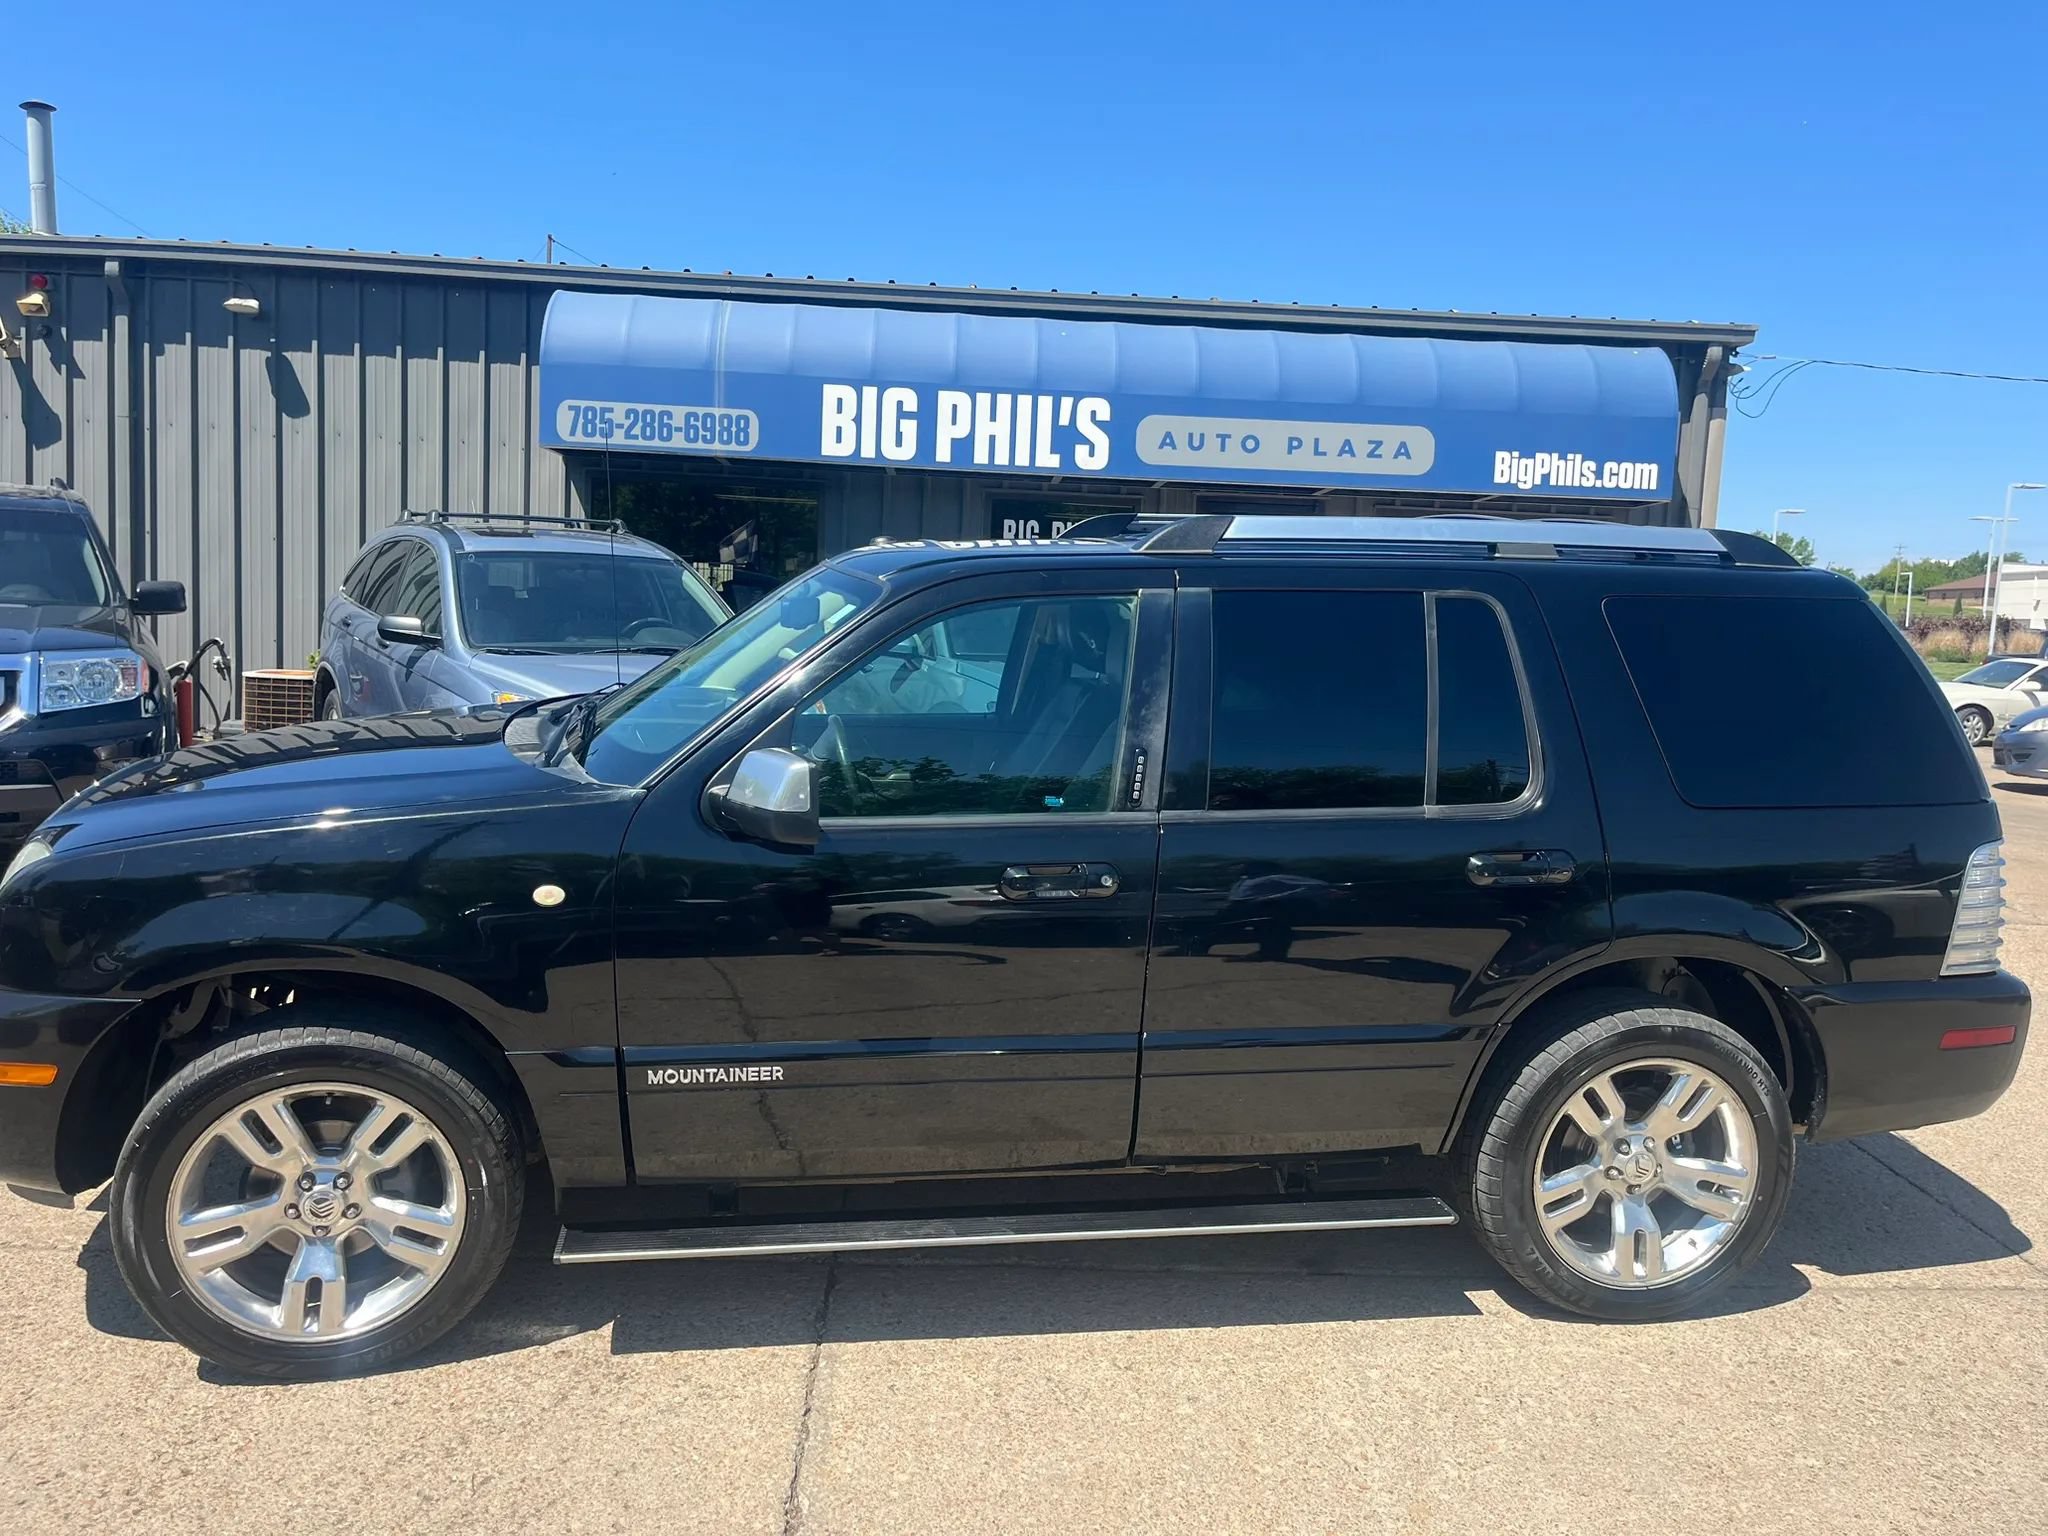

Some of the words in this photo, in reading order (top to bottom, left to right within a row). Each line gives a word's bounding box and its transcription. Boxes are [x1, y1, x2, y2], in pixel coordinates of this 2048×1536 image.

[568, 405, 750, 447] 785-286-6988
[821, 384, 918, 461] BIG
[935, 390, 1111, 471] PHIL'S
[1158, 431, 1260, 454] AUTO
[1286, 436, 1412, 460] PLAZA
[1494, 450, 1659, 490] BigPhils.com
[647, 1066, 784, 1085] MOUNTAINEER
